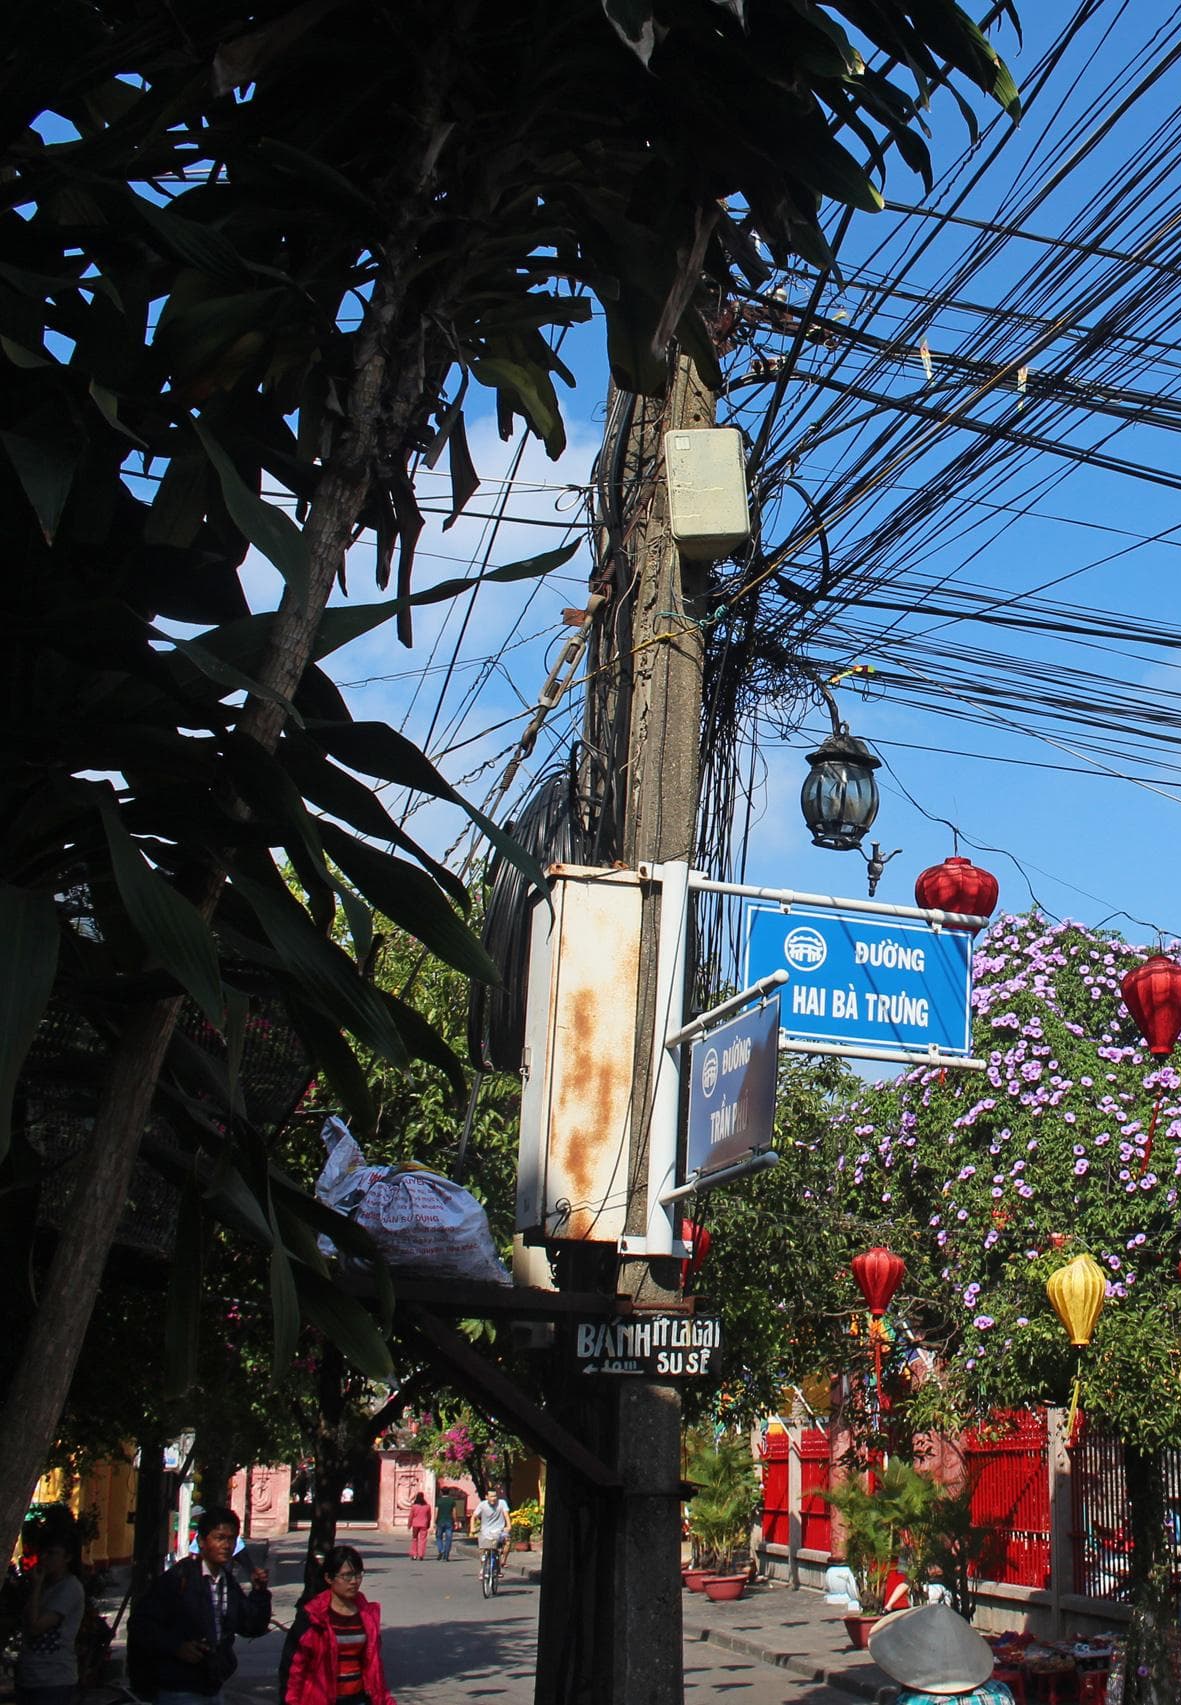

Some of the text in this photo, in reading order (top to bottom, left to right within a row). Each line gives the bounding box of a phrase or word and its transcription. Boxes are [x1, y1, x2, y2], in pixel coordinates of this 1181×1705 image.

[855, 938, 925, 973] ĐƯỜNG
[792, 983, 929, 1028] HAI BÀ TRƯNG
[721, 1035, 752, 1076] ĐƯỜNG
[710, 1093, 732, 1145] TRẦN
[577, 1316, 651, 1358] BÁNH
[657, 1348, 711, 1375] SU SÊ
